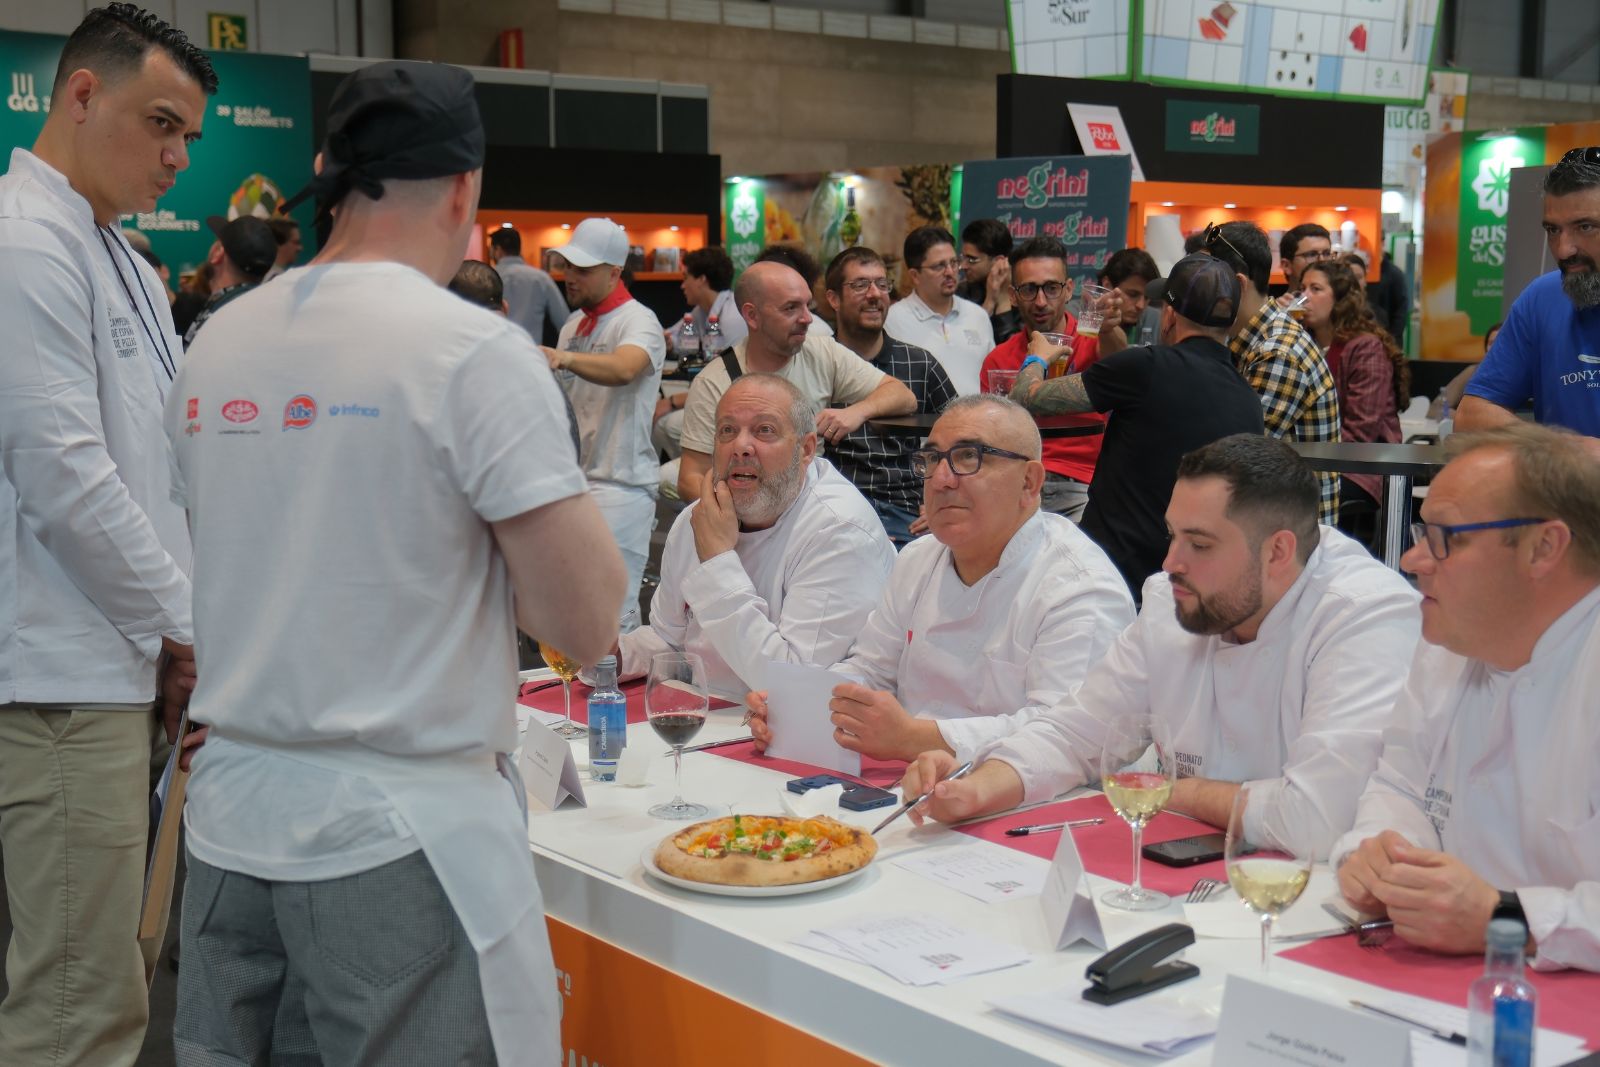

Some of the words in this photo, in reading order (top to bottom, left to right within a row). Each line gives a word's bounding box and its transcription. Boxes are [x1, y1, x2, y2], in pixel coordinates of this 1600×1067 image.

[1062, 7, 1090, 26] Sur
[234, 117, 294, 129] GOURMETS
[1190, 112, 1235, 142] negrini
[997, 161, 1088, 209] negrini
[137, 220, 200, 231] GOURMETS
[1044, 211, 1109, 245] negrini
[1469, 225, 1507, 252] gus
[1175, 751, 1203, 767] PEONATO
